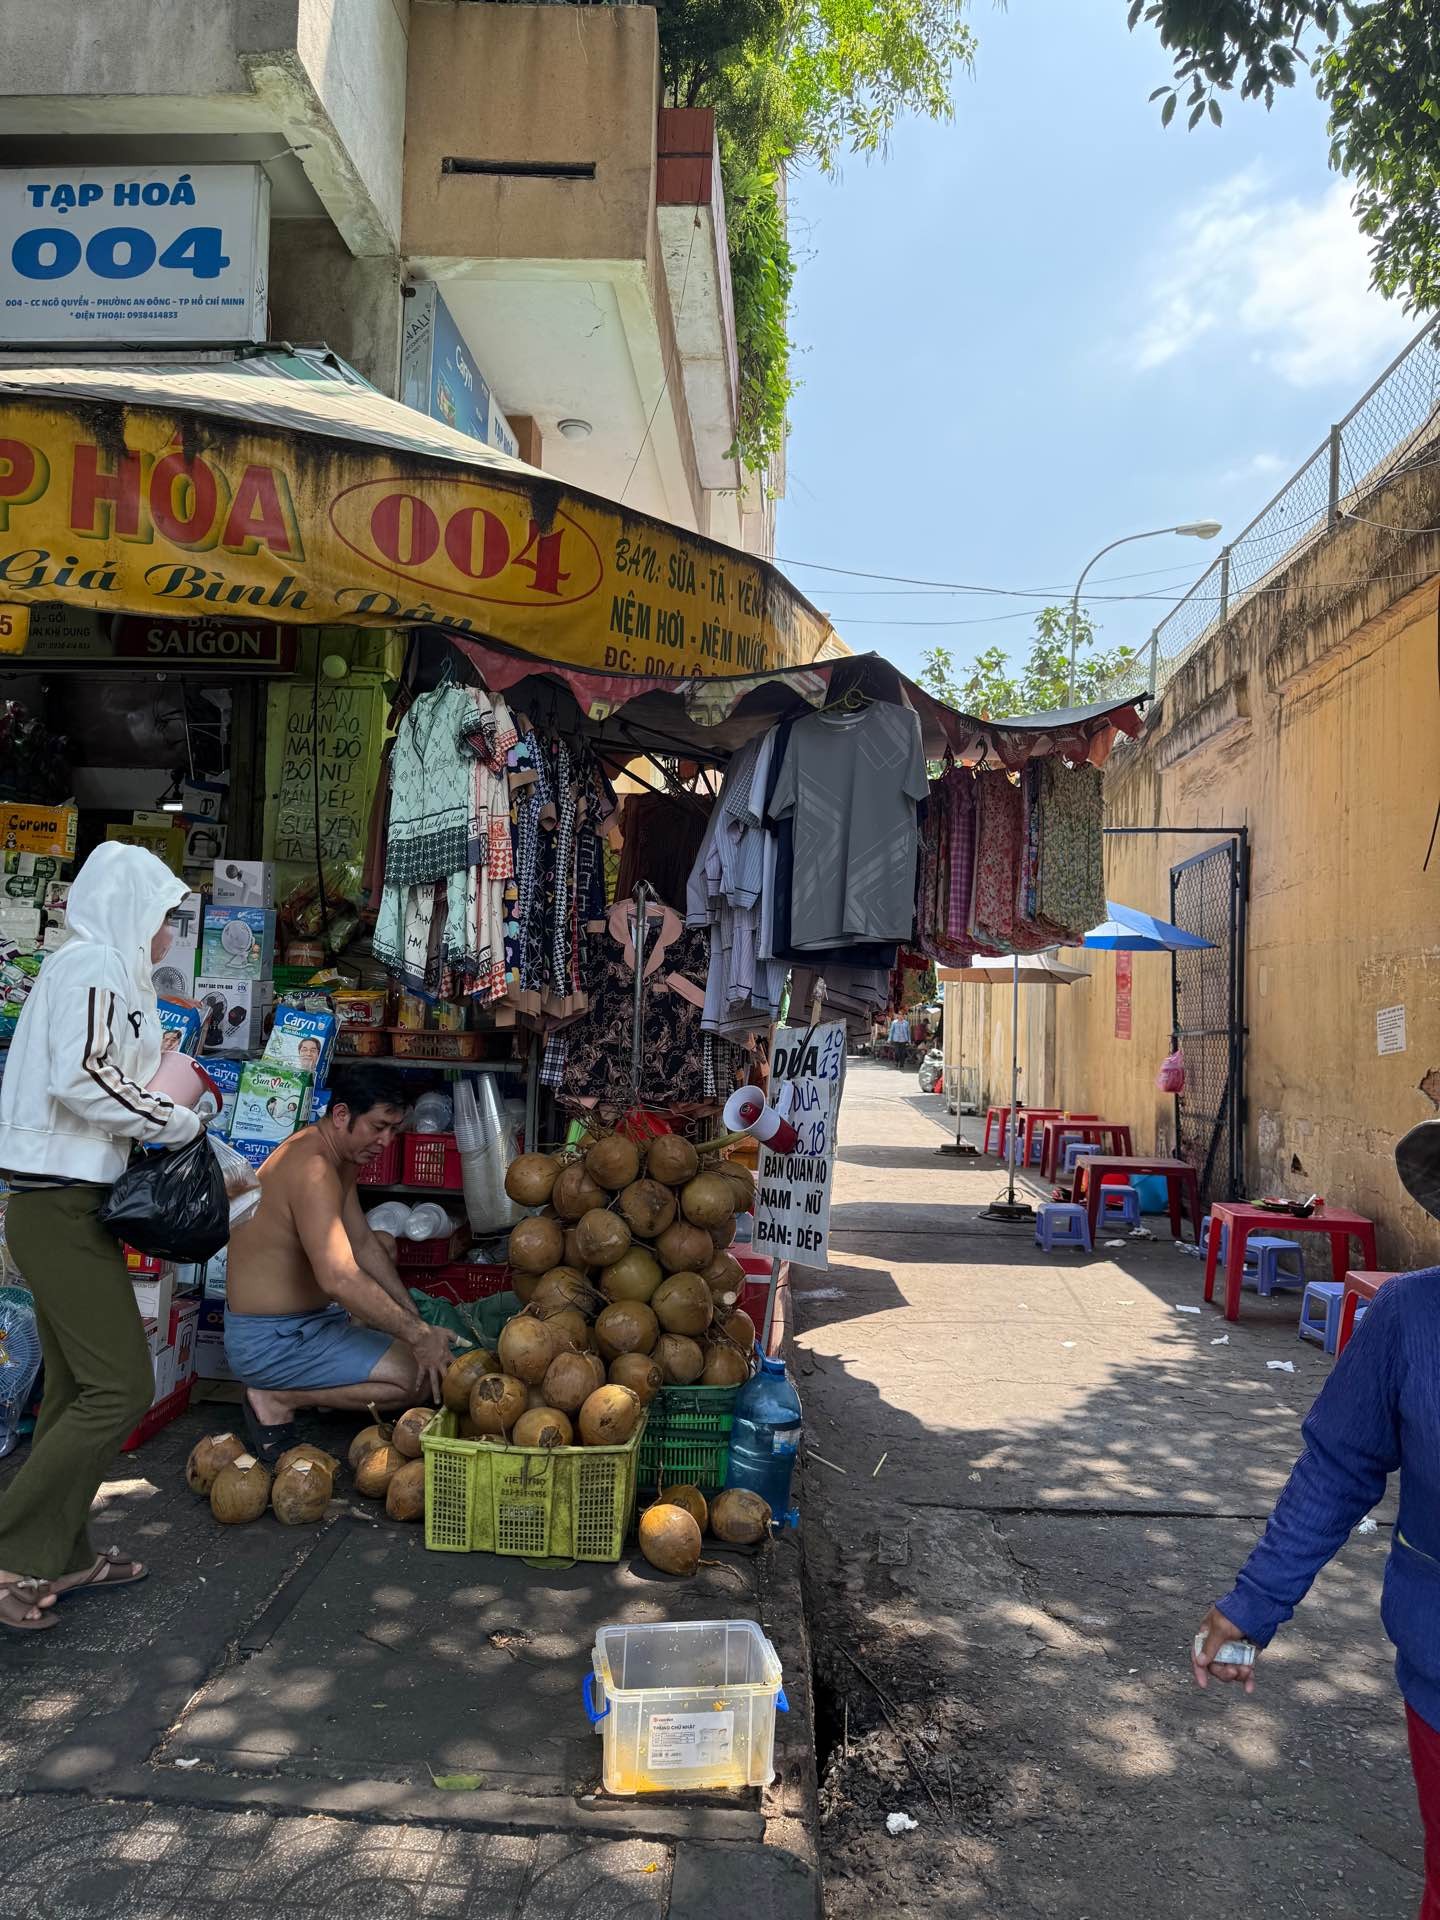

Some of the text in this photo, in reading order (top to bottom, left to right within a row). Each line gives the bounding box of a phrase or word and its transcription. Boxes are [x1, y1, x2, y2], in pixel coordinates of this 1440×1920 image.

[27, 174, 196, 214] TẠP HOÁ
[11, 227, 231, 280] 004
[180, 298, 190, 306] TP
[221, 298, 244, 306] MINH
[371, 492, 571, 597] 004
[1, 549, 123, 592] Giá
[144, 562, 314, 611] Bình
[668, 550, 697, 596] SỮA
[709, 563, 726, 606] TÃ
[147, 629, 261, 655] SAIGON
[609, 590, 652, 644] NỆM
[656, 608, 685, 650] HƠI
[700, 616, 734, 666] NỆM
[604, 645, 637, 673] ĐC:
[9, 815, 58, 833] Corona
[284, 1012, 316, 1031] Caryn
[823, 1029, 844, 1053] 10
[206, 1064, 239, 1082] Caryn
[819, 1052, 839, 1080] 13
[235, 1139, 269, 1154] Caryn
[760, 1187, 792, 1210] NAM
[805, 1189, 824, 1215] NỮ
[796, 1225, 823, 1252] DÉP
